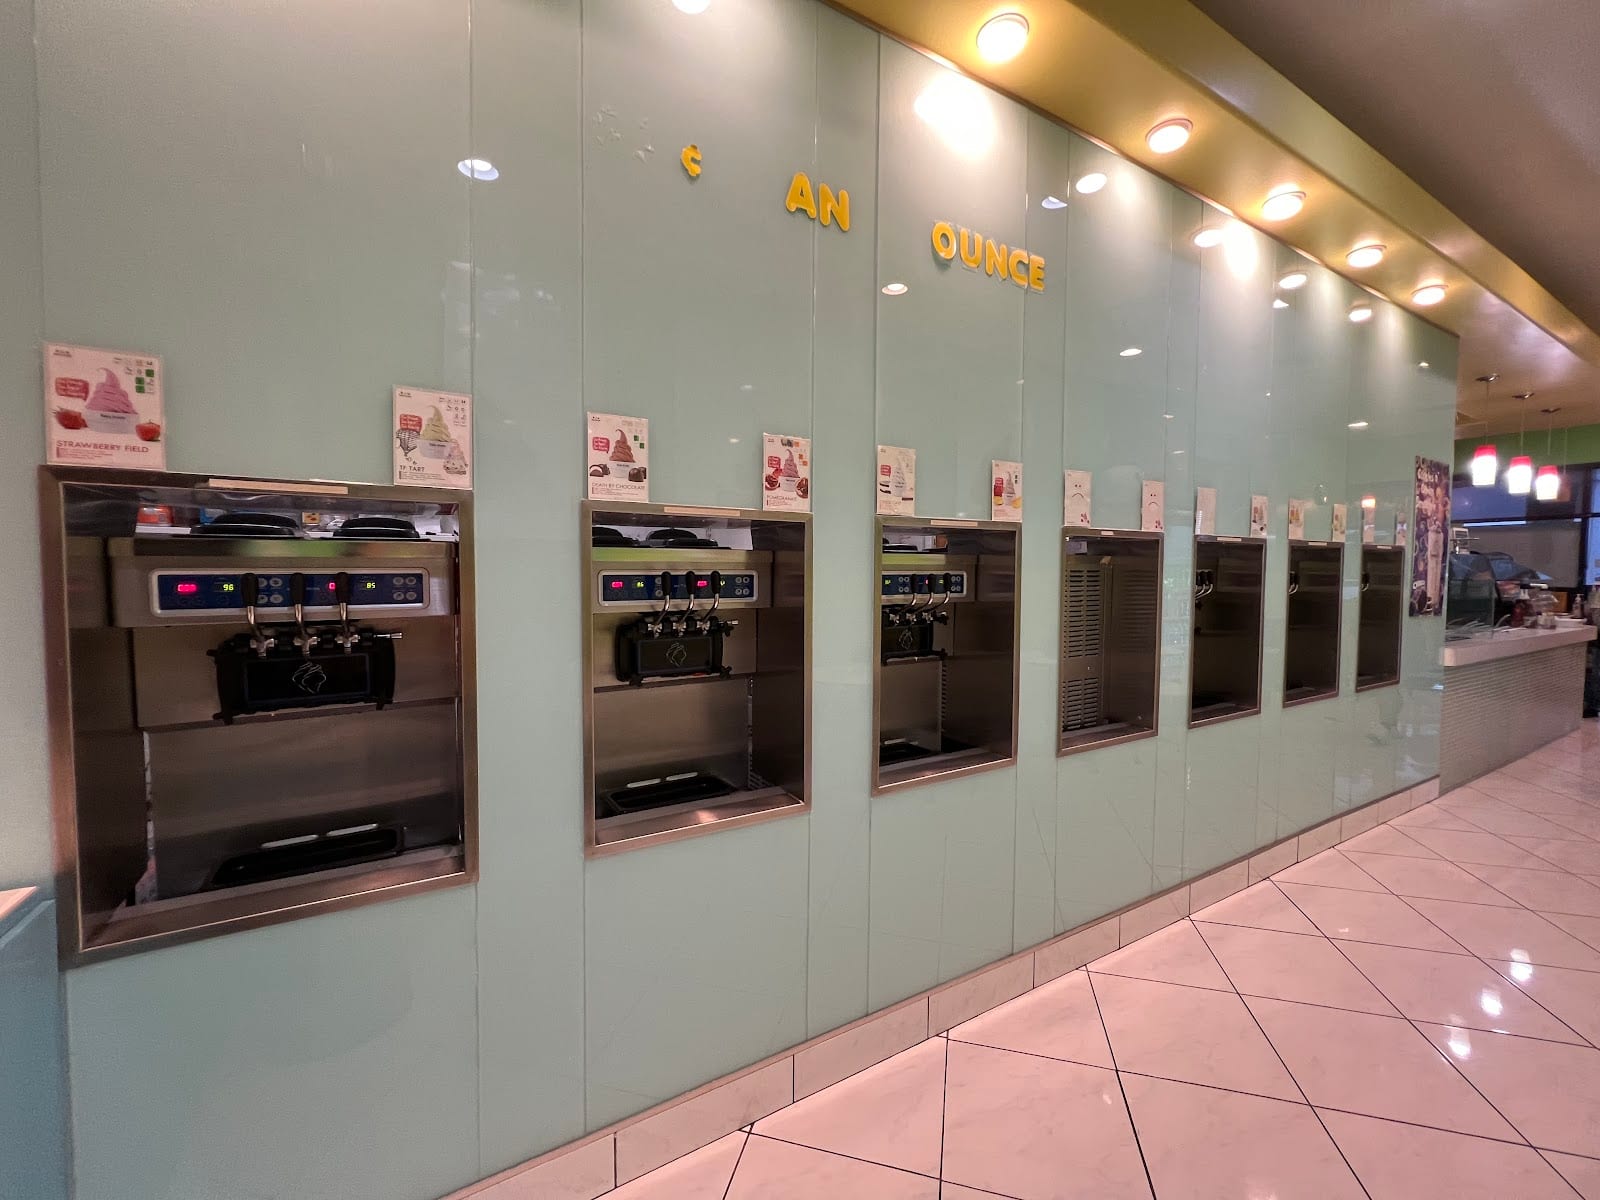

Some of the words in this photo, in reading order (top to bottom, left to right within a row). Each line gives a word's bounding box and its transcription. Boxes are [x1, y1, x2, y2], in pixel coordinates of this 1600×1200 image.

[785, 171, 850, 232] AN
[931, 221, 1046, 291] OUNCE
[56, 440, 120, 451] STRAWBERRY
[124, 445, 149, 453] FIELD
